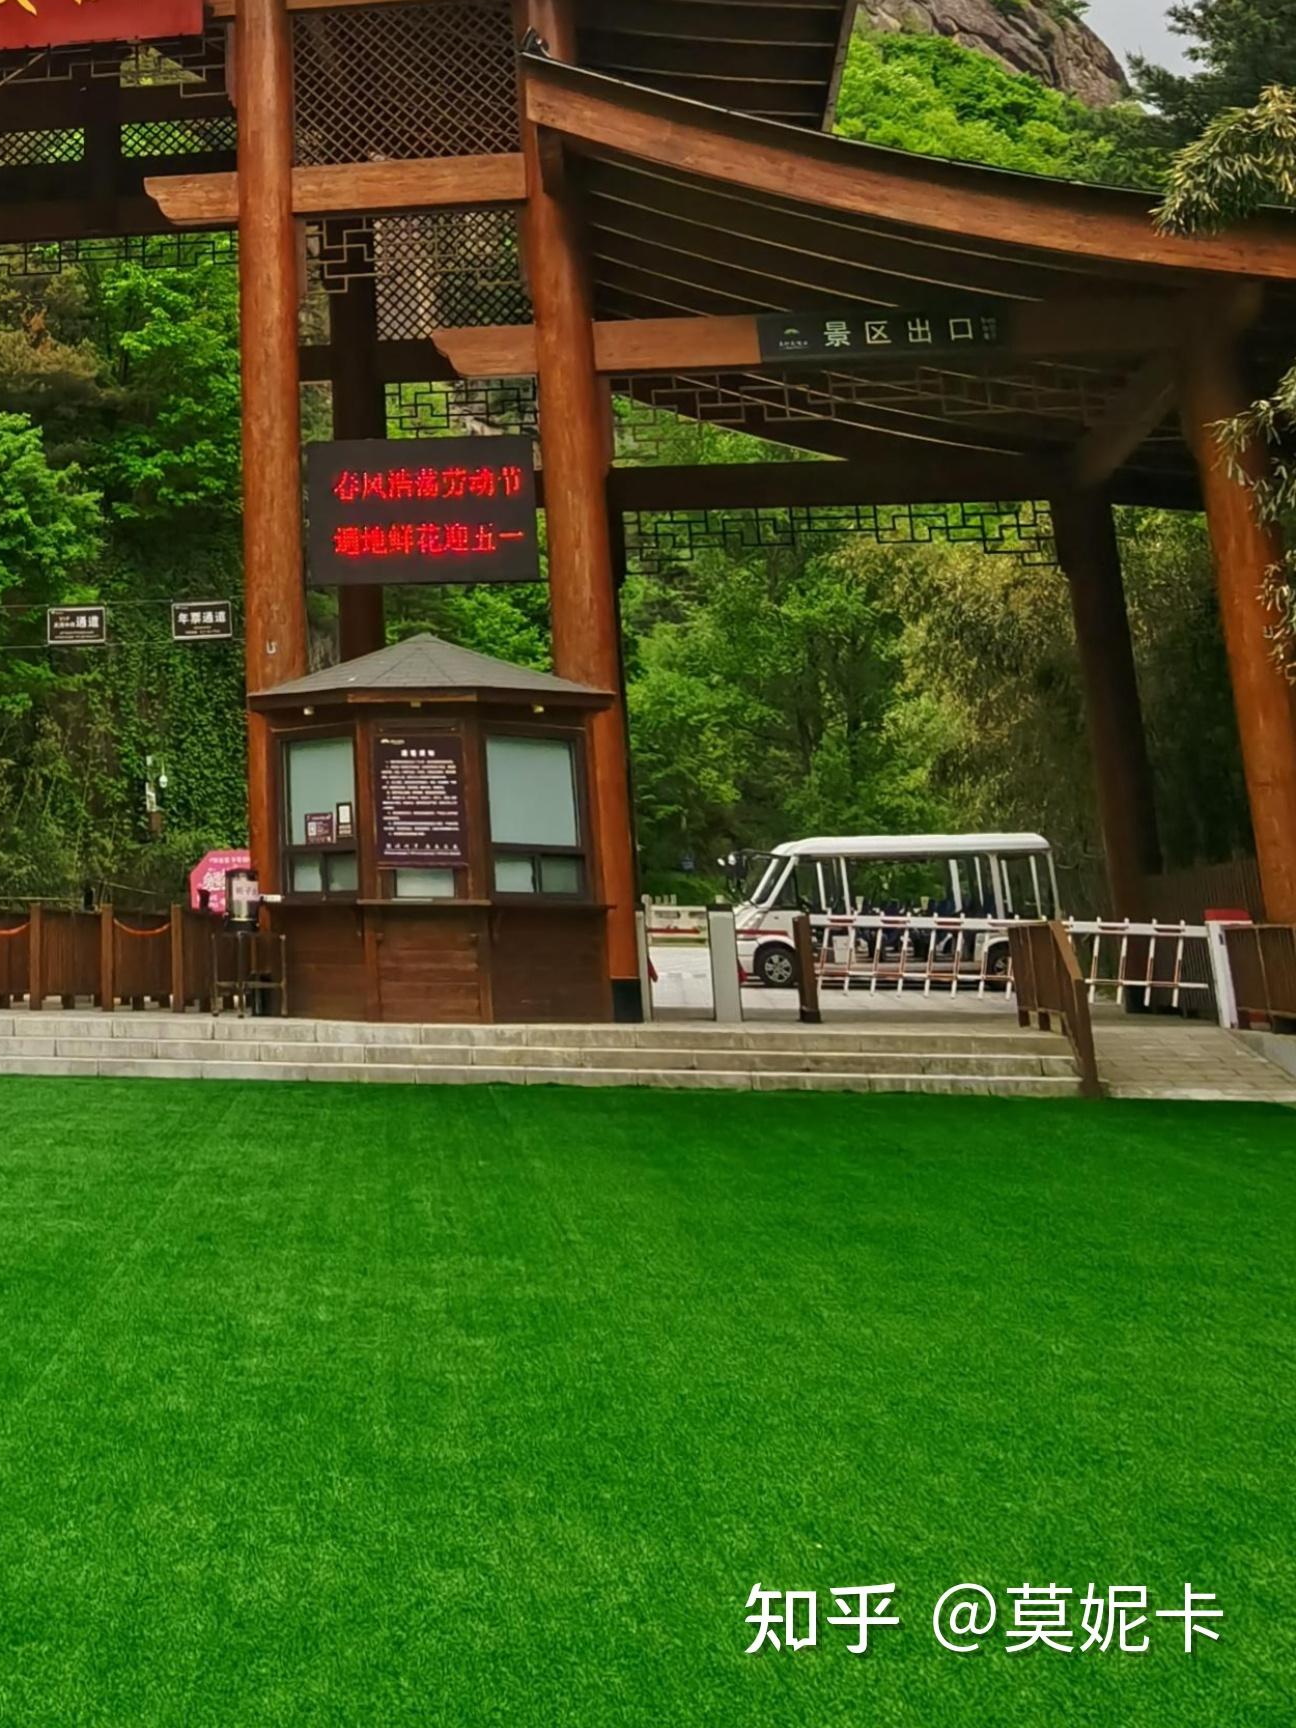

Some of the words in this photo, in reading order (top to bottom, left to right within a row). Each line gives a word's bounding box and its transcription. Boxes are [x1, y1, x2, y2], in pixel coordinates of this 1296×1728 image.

[823, 318, 974, 347] 景区出口
[334, 467, 522, 500] 春风浩荡劳动节
[333, 523, 524, 556] 遍地鲜花迎五一
